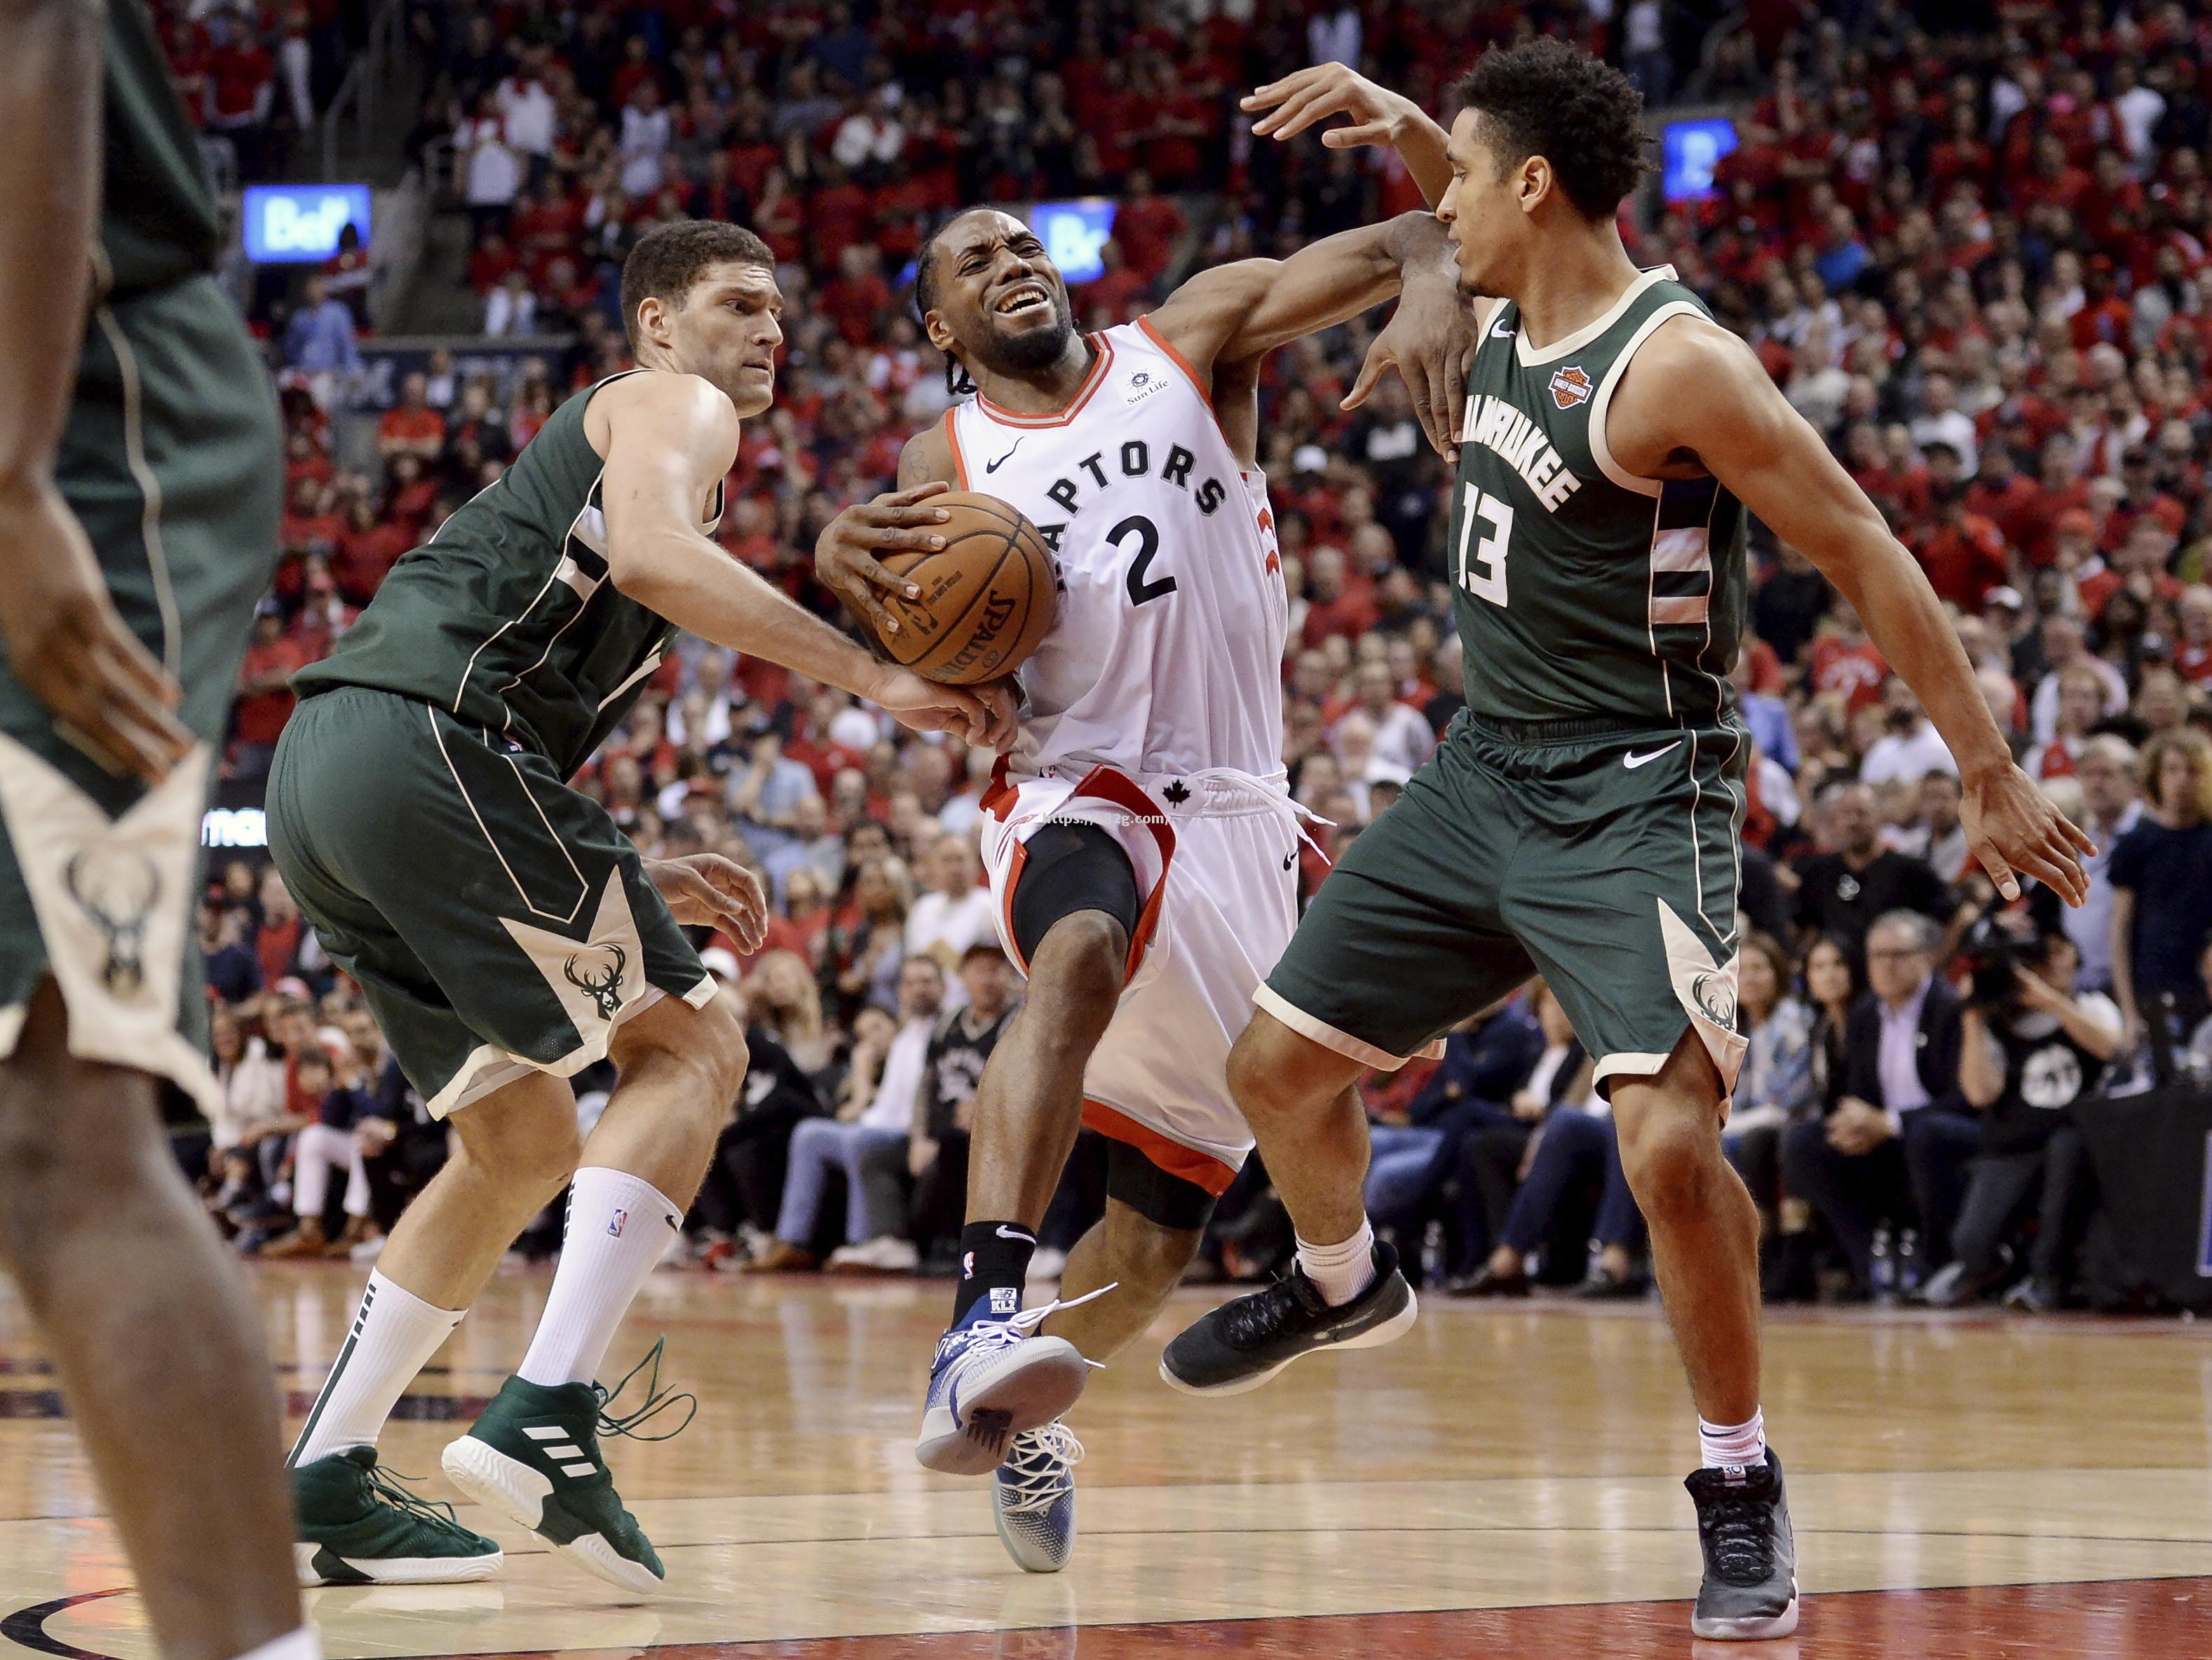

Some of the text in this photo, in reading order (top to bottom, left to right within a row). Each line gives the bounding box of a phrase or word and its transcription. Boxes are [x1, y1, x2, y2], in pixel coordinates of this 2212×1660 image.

[1127, 380, 1170, 405] Sun Life
[1038, 439, 1228, 595] APTORS
[1105, 515, 1178, 607] 2
[1458, 481, 1514, 607] 13
[991, 1300, 1016, 1311] KL2
